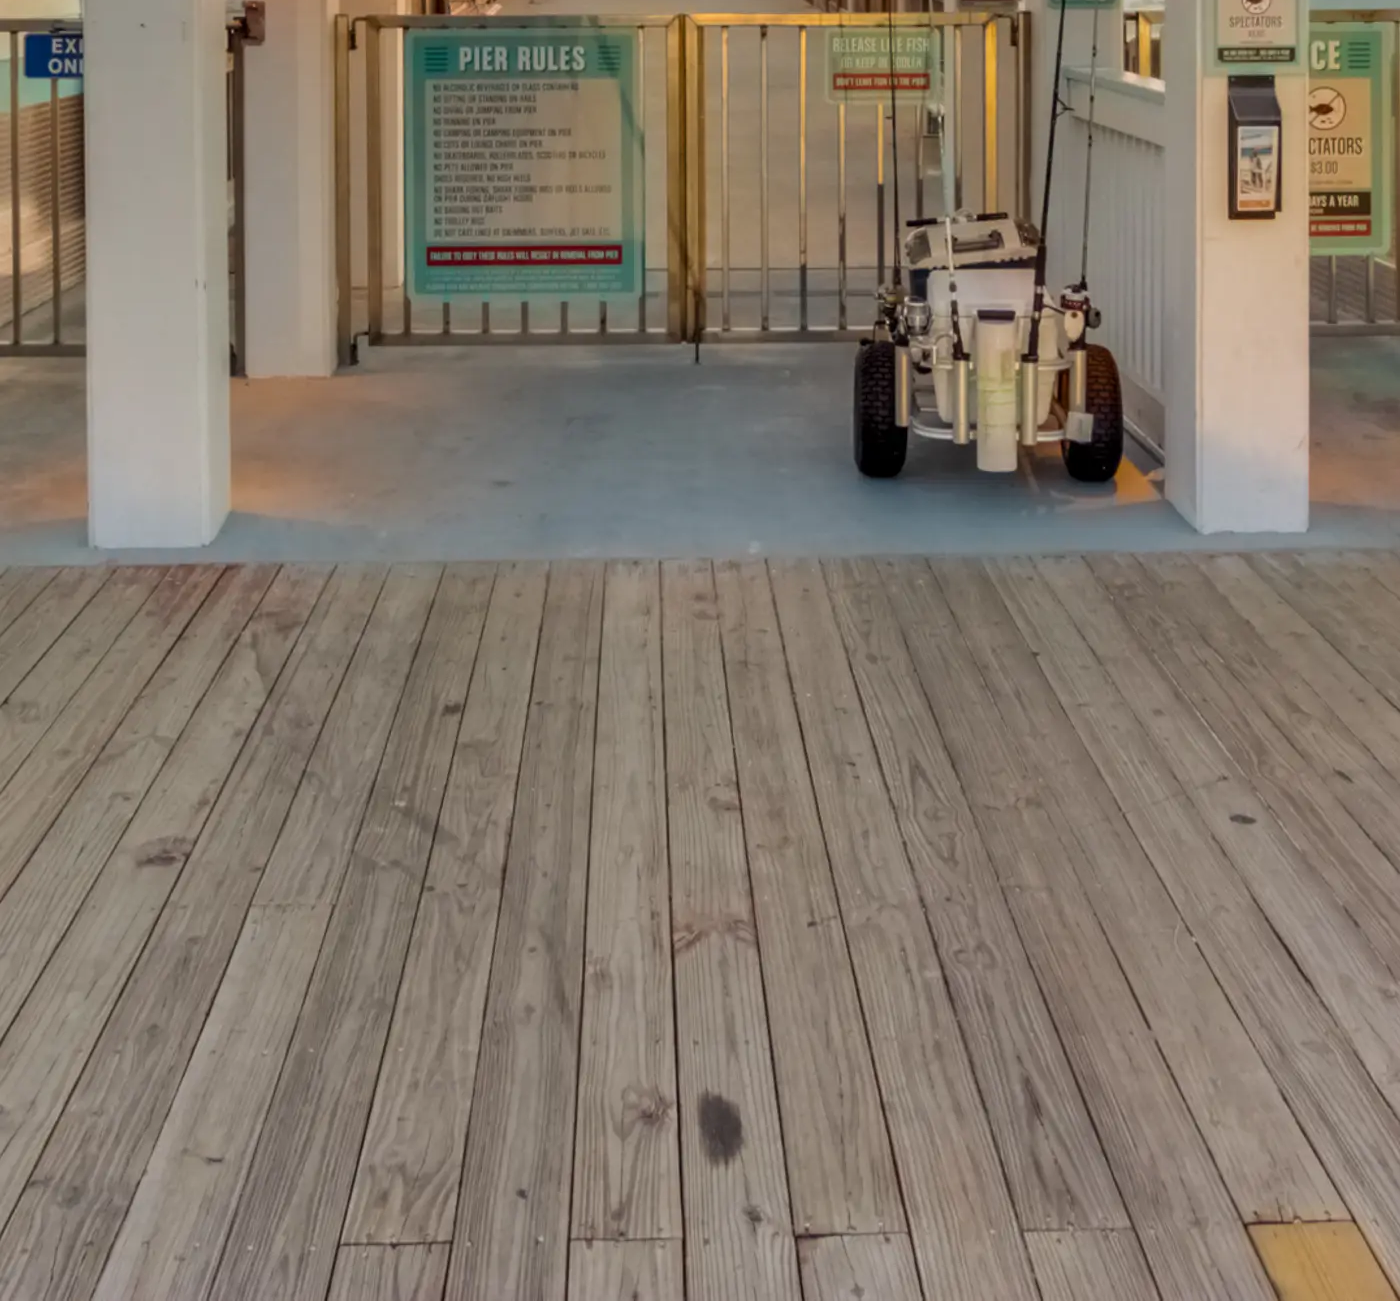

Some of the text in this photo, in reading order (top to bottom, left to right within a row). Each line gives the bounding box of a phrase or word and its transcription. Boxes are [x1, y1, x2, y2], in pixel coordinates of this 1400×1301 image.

[1229, 15, 1282, 28] SPECTATORS
[52, 38, 84, 53] EXI
[833, 38, 877, 52] RELEASE
[907, 38, 929, 52] FISH
[460, 47, 586, 71] PIER RULES
[1310, 40, 1340, 70] CE
[893, 57, 922, 68] OOLER
[1308, 138, 1363, 155] CTATORS
[1310, 160, 1338, 174] $3.00
[1309, 195, 1359, 207] AYS A YEAR
